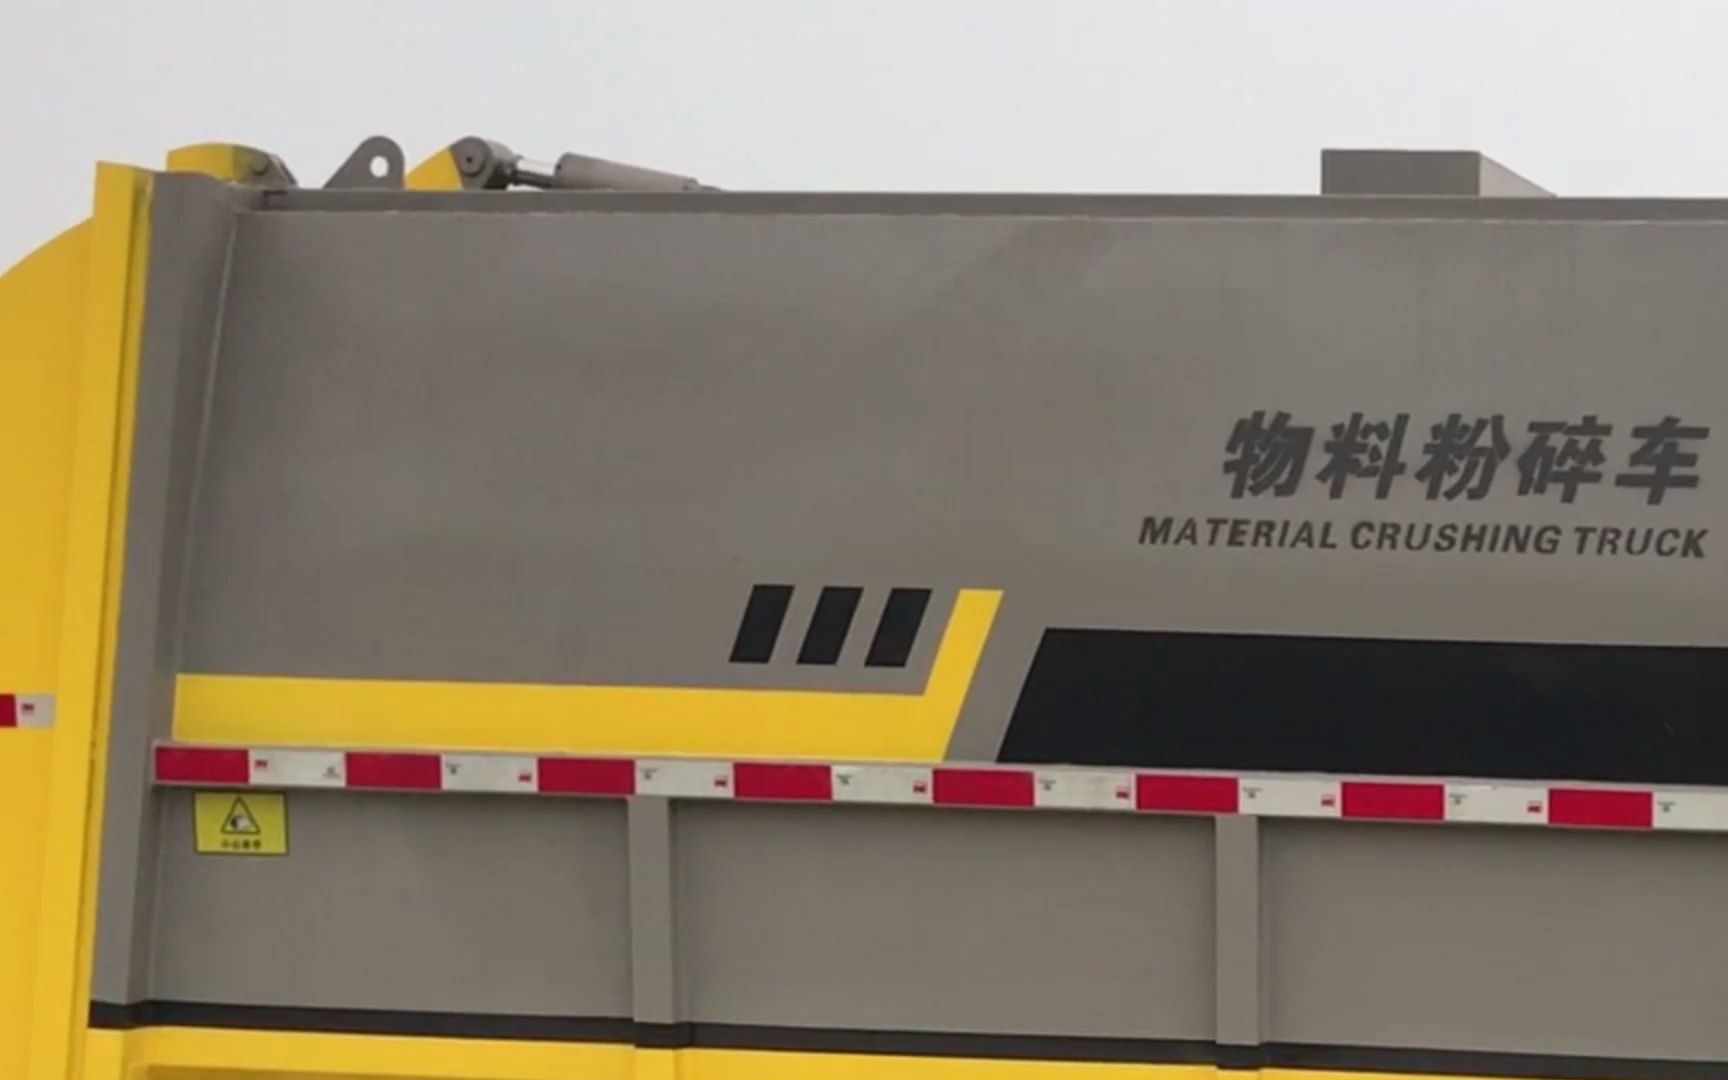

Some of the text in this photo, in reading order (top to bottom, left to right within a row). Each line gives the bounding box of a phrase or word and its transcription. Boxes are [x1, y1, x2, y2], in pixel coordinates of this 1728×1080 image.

[1222, 410, 1711, 506] 物料粉碎车
[1137, 515, 1711, 560] MATERIAL CRUSHING TRUCK
